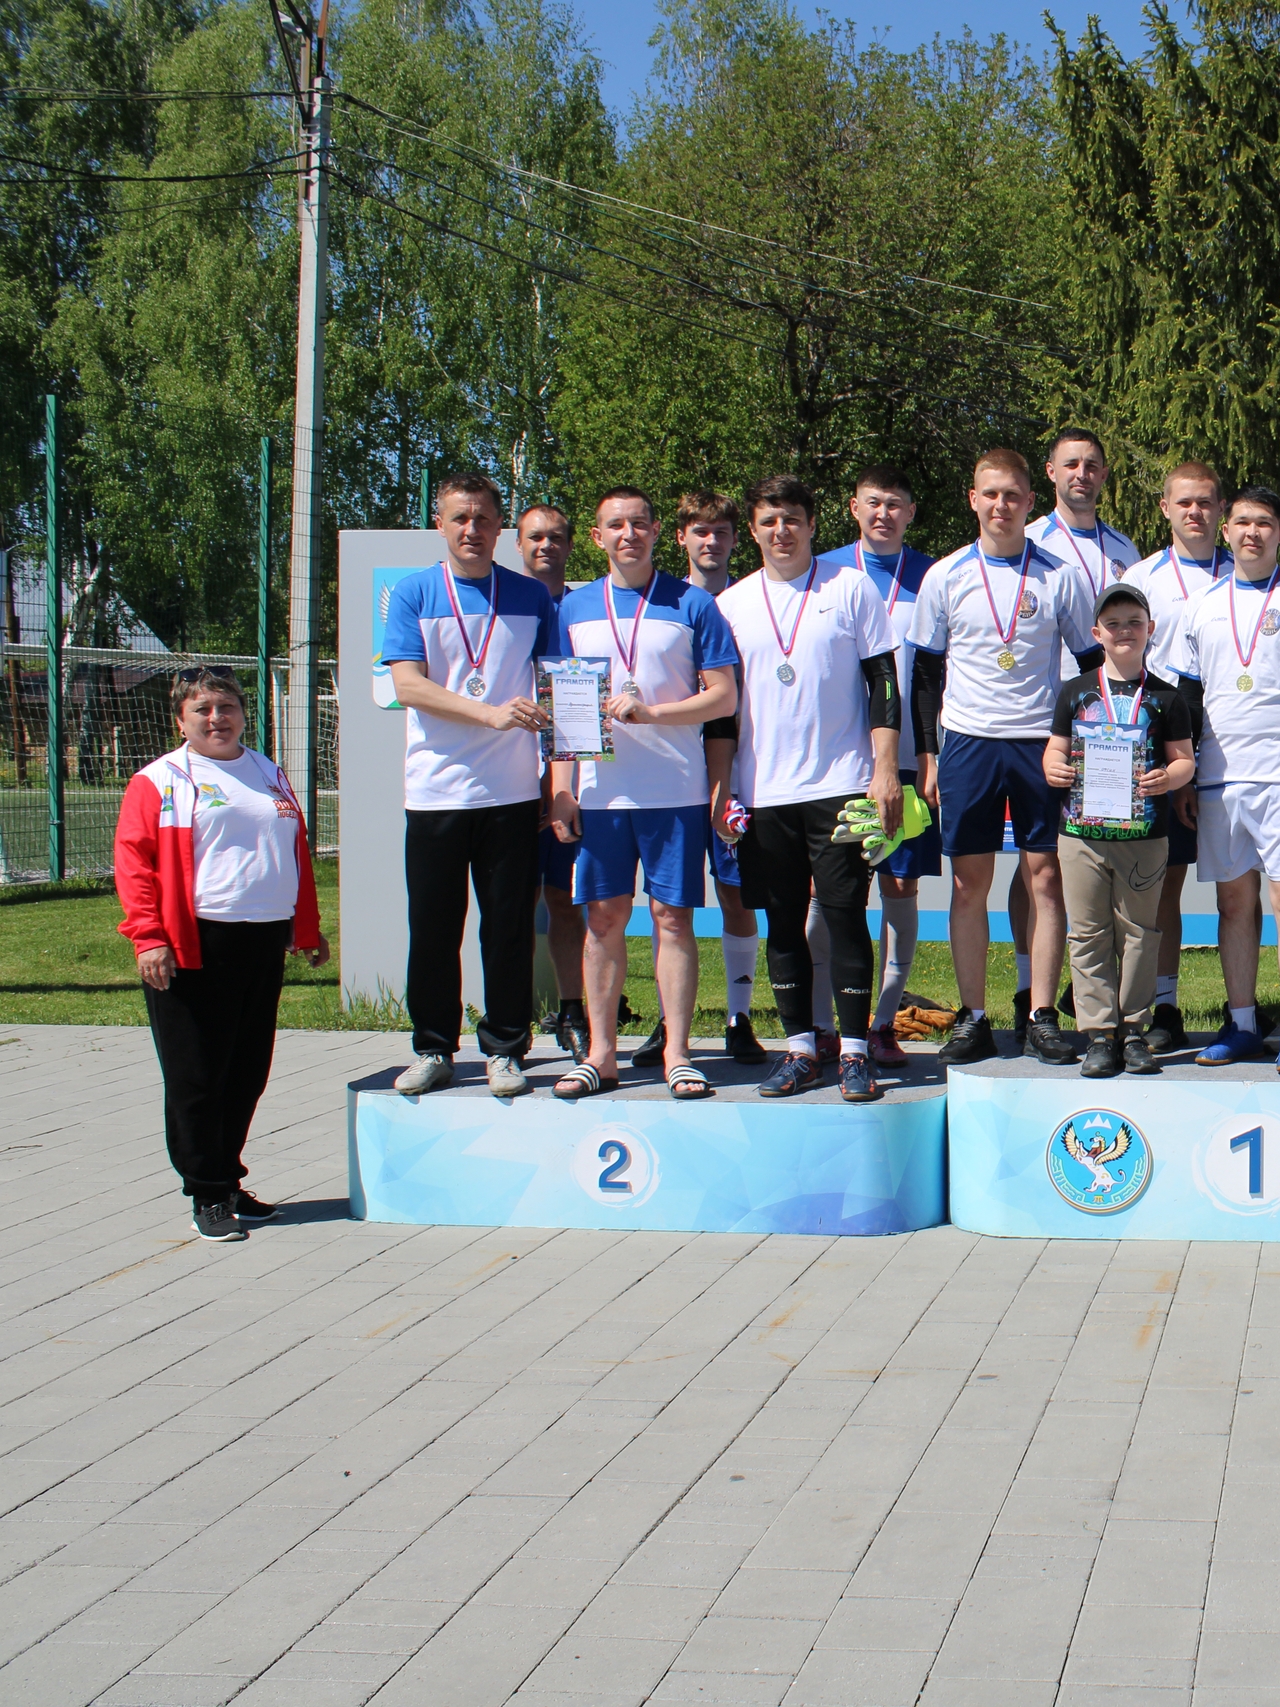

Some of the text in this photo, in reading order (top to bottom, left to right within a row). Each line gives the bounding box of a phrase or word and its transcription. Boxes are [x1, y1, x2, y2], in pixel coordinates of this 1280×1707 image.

[555, 678, 595, 686] ГРАМОТА
[1088, 743, 1129, 753] ГРАМОТА
[598, 1139, 634, 1194] 2
[1230, 1125, 1264, 1199] 1
